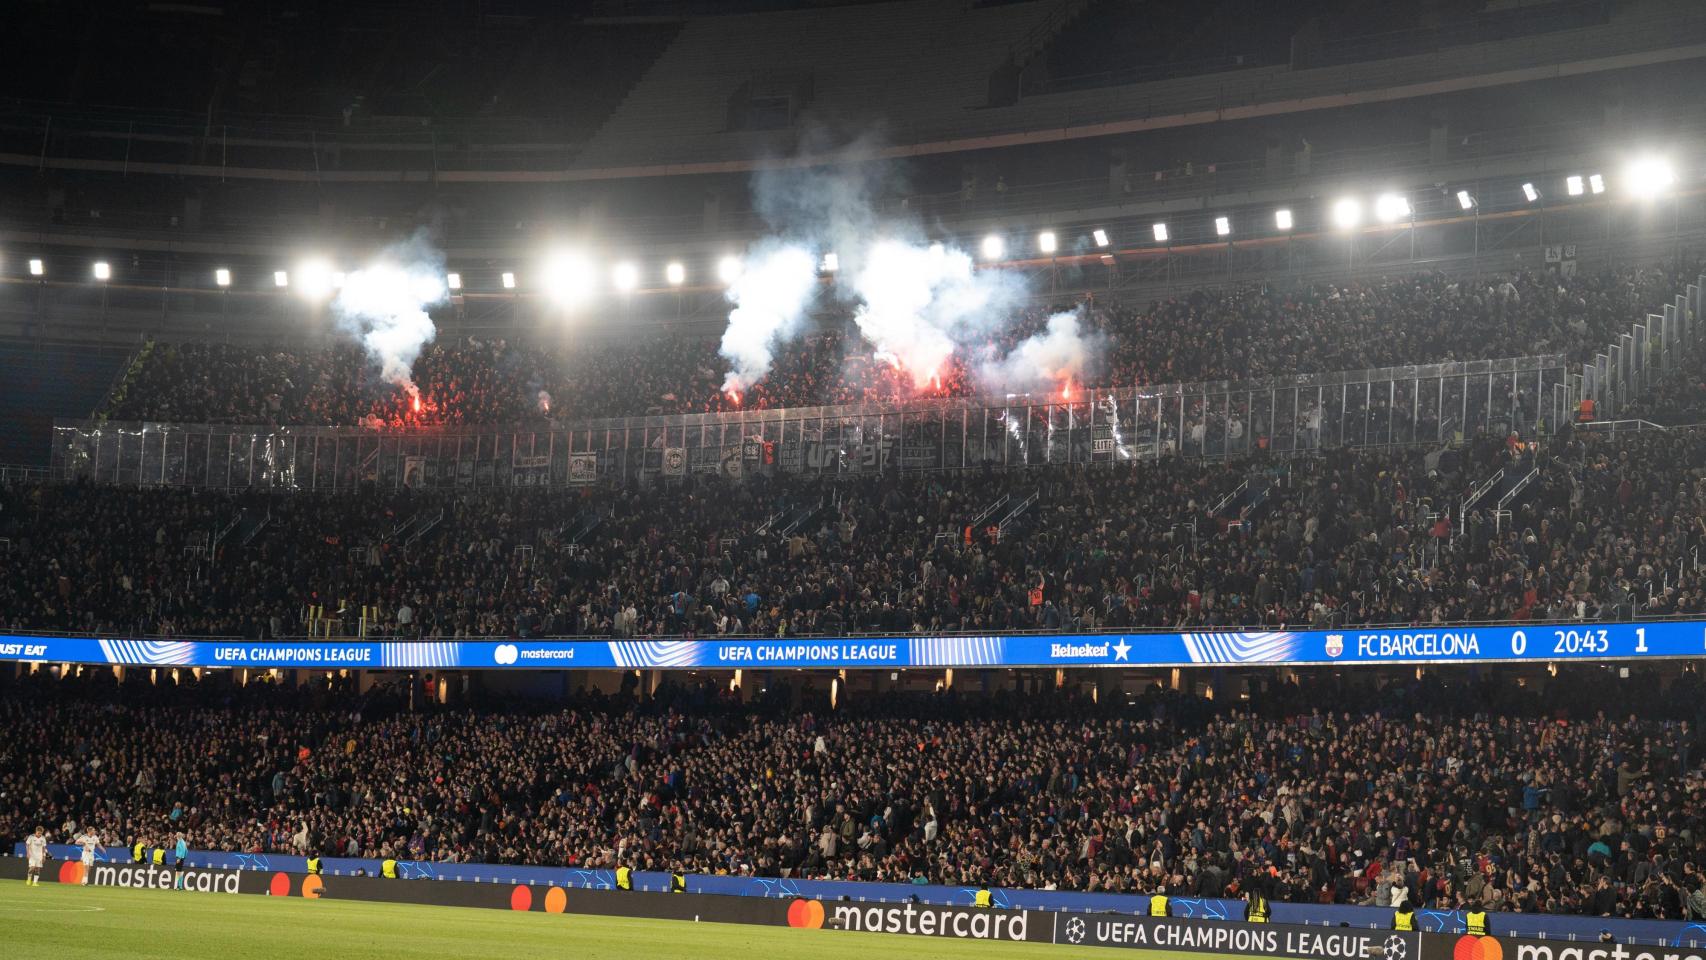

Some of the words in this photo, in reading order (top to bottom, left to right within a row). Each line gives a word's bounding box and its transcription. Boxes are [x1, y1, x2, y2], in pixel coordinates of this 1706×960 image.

[0, 643, 24, 655] UST
[24, 645, 47, 656] EAT
[1051, 643, 1108, 657] Heineken
[1357, 634, 1378, 655] FC
[1379, 633, 1480, 655] BARCELONA
[1511, 631, 1527, 654] 0
[1553, 630, 1609, 652] 20:43
[1635, 628, 1649, 653] 1
[214, 647, 247, 661] UEFA
[250, 648, 322, 661] CHAMPIONS
[325, 648, 371, 662] LEAGUE
[520, 648, 574, 659] mastercard
[718, 646, 753, 661] UEFA
[756, 645, 839, 661] CHAMPIONS
[842, 644, 897, 660] LEAGUE
[835, 904, 1028, 941] mastercard
[1096, 921, 1148, 944] UEFA
[1153, 924, 1278, 952] CHAMPIONS
[1286, 932, 1371, 958] LEAGUE
